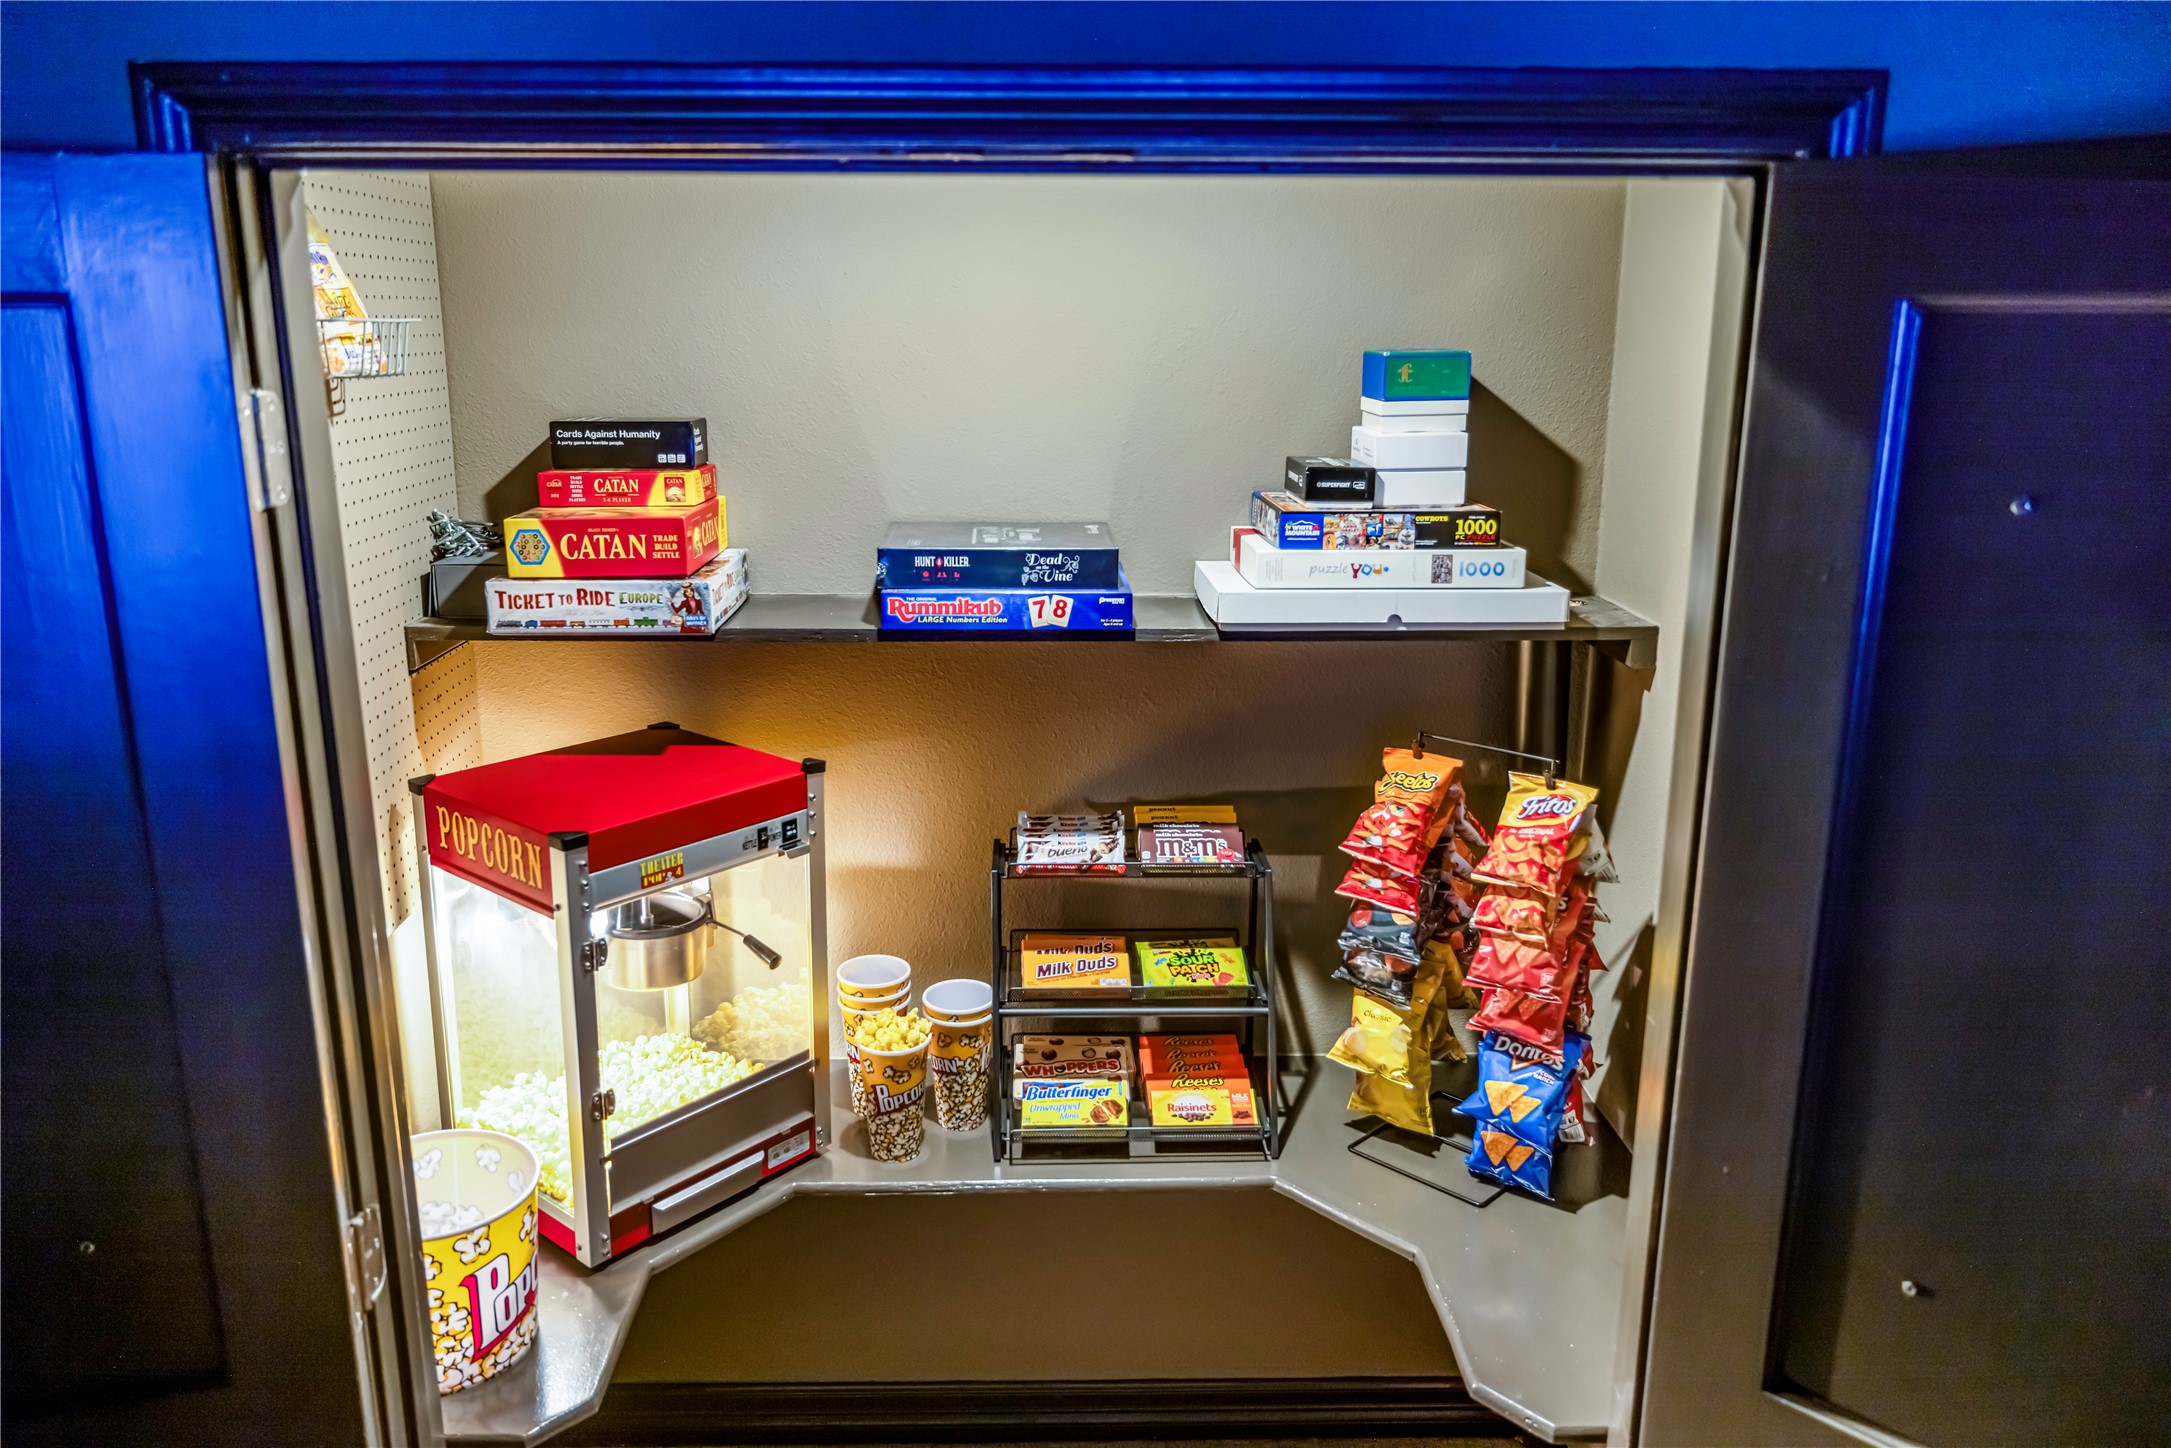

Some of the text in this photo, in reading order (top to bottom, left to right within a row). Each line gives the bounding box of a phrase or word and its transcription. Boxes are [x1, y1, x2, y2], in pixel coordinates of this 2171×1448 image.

[556, 430, 661, 440] Cards Against Humanity
[593, 479, 639, 492] CATAN
[1455, 520, 1497, 535] 1000
[560, 533, 647, 560] CATAN
[652, 551, 680, 559] SETTLE
[914, 556, 935, 567] HUNT
[1026, 553, 1063, 566] Dead
[1040, 569, 1073, 582] Vine
[1459, 561, 1505, 577] 1000
[494, 588, 663, 610] TICKET TO RIDE EUROPE
[888, 597, 1002, 623] Rummikub
[1032, 599, 1067, 619] 7 8
[1517, 795, 1576, 819] Fritos
[436, 805, 542, 890] POPCORN
[1048, 846, 1088, 857] bueno
[640, 852, 683, 876] THEATER
[1036, 956, 1117, 978] Milk Duds
[1169, 955, 1215, 966] SOUR
[1169, 963, 1219, 976] PATCH
[1024, 1060, 1119, 1076] WHOPPERS
[1168, 1060, 1220, 1073] Reese's
[1172, 1074, 1225, 1088] Reese's
[1026, 1087, 1112, 1101] Butterfinger
[1030, 1102, 1080, 1113] Unwrapped
[1167, 1103, 1217, 1112] Raisinets
